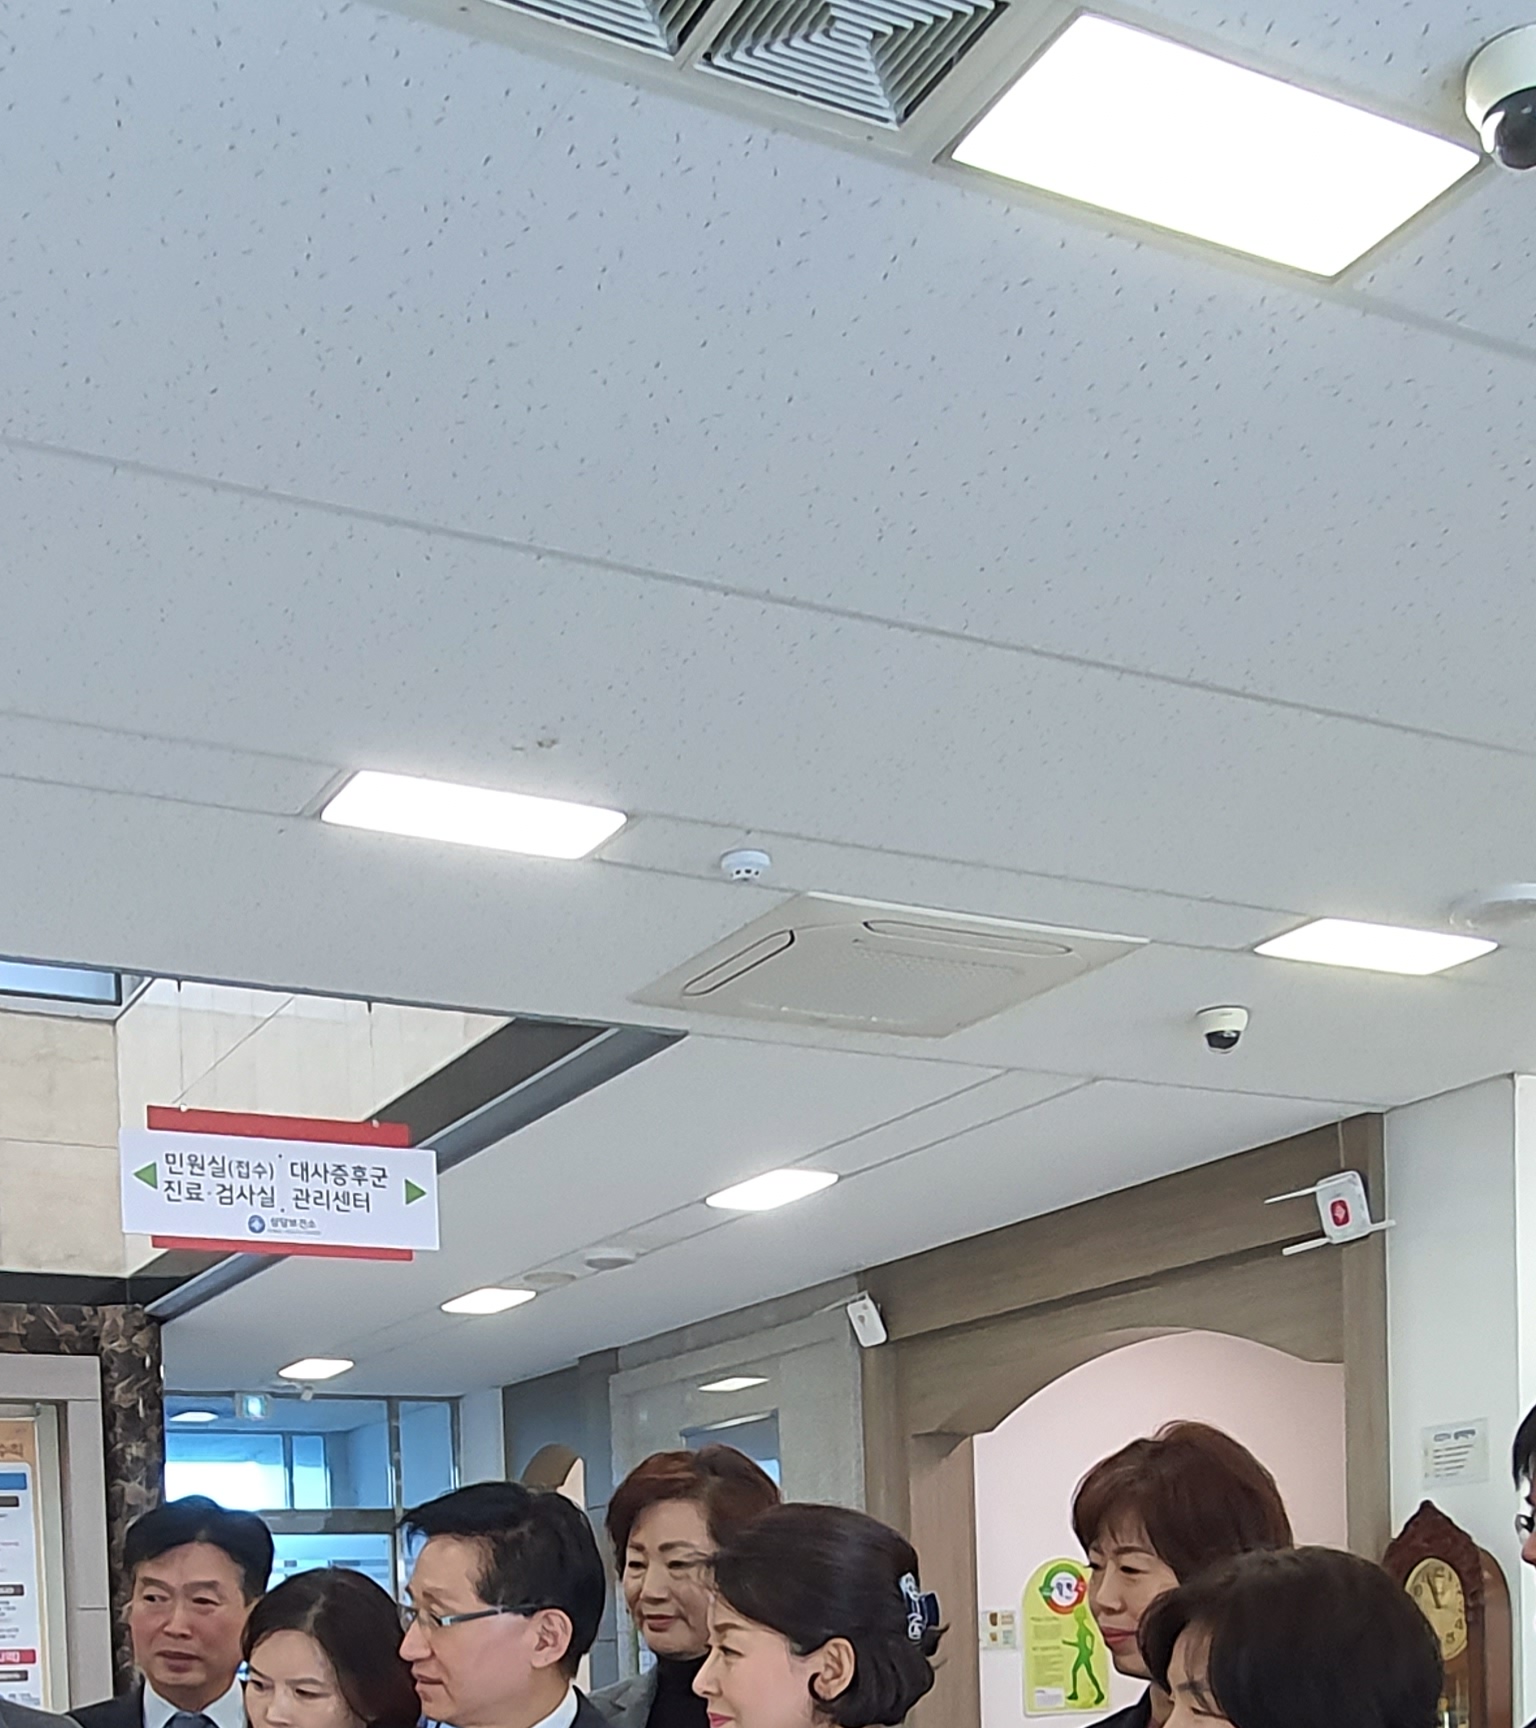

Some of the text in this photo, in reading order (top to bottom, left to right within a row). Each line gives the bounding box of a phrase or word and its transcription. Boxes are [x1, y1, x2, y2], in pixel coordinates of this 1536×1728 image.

[164, 1153, 275, 1181] 민원실(접수)
[290, 1161, 388, 1189] 대사증후군
[292, 1188, 371, 1213] 관리센터
